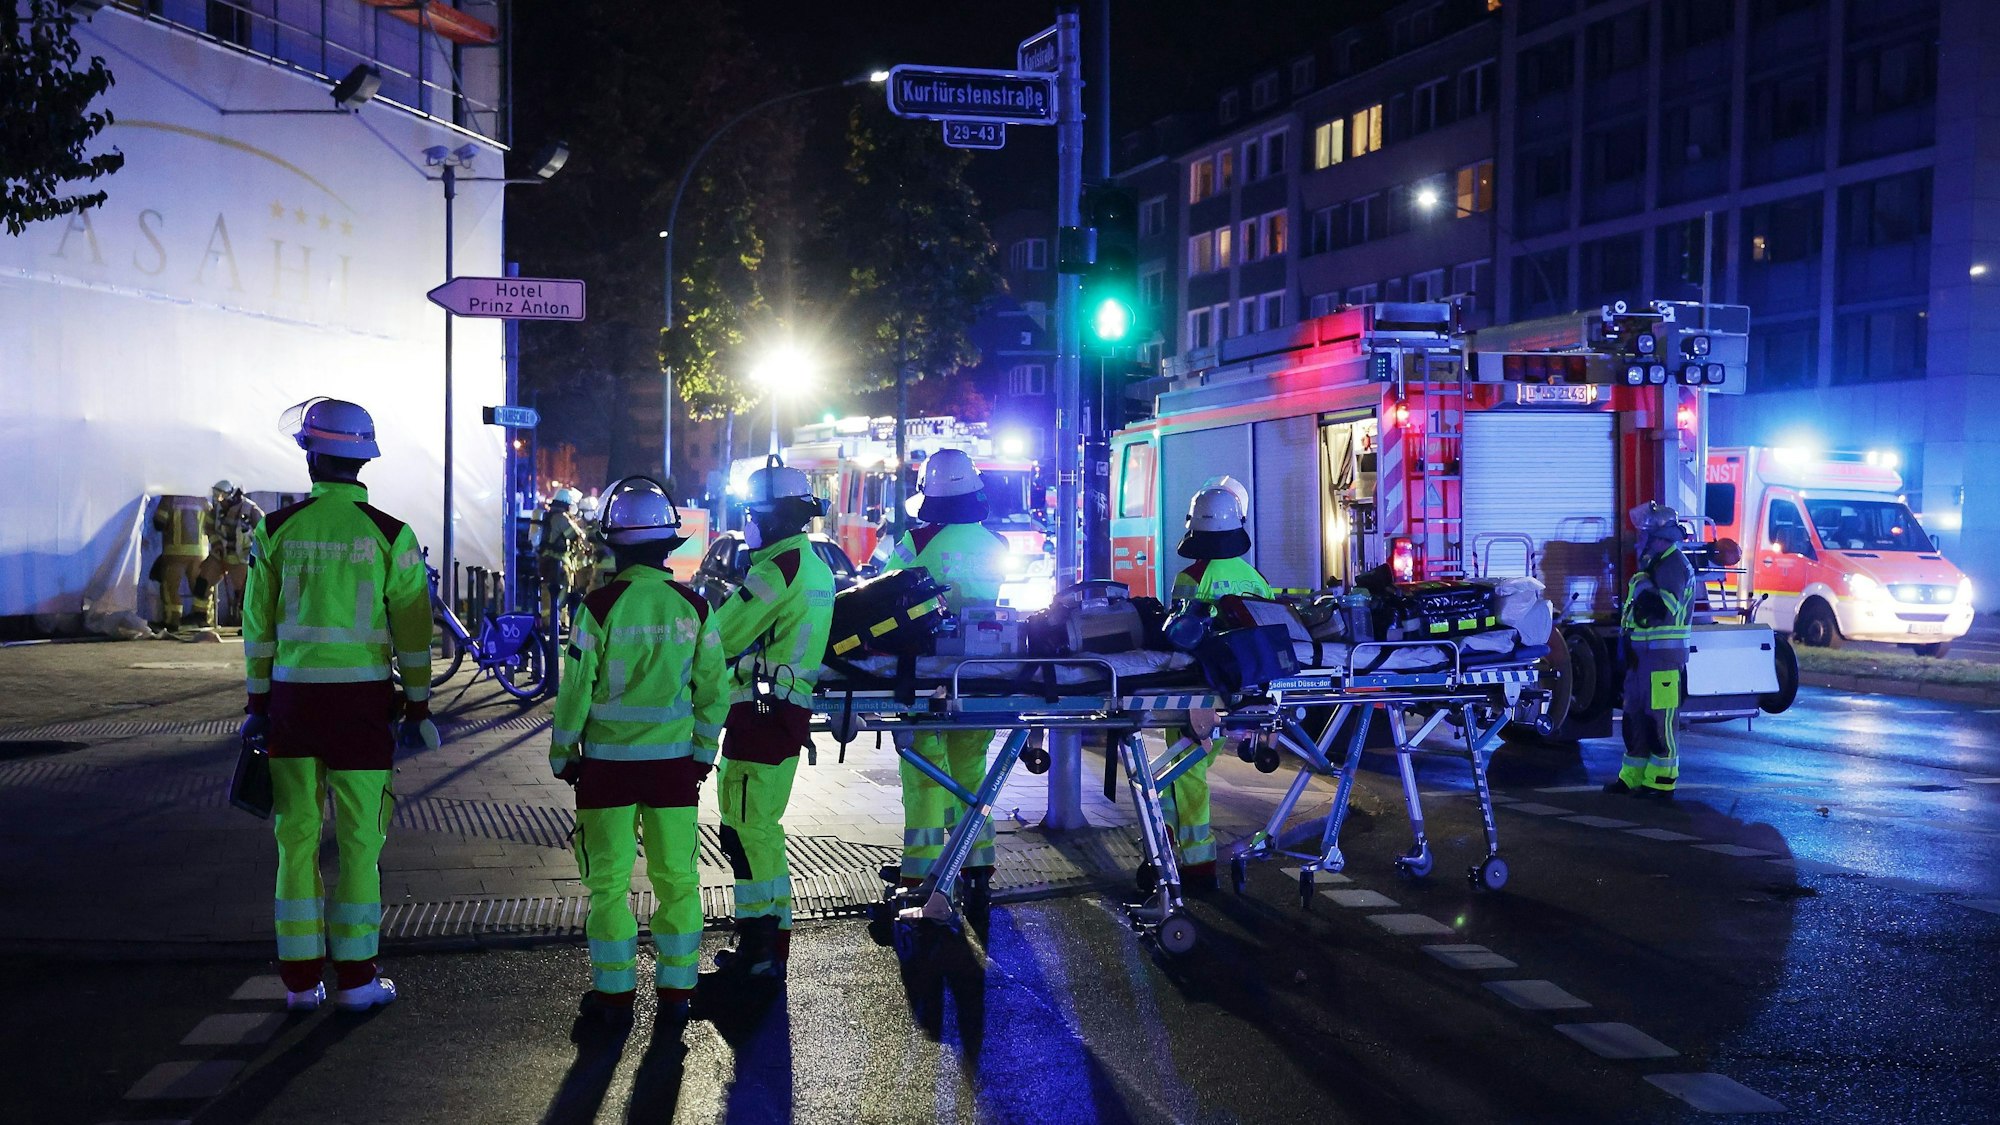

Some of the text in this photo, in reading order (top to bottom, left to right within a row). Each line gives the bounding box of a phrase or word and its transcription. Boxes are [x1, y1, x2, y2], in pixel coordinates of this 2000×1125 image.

[903, 80, 1043, 109] Kurfürstenstraße
[953, 125, 995, 141] 29-43
[49, 207, 354, 305] ASAHI
[496, 282, 542, 298] Hotel
[469, 297, 570, 315] Prinz Anton
[1430, 410, 1439, 433] 1
